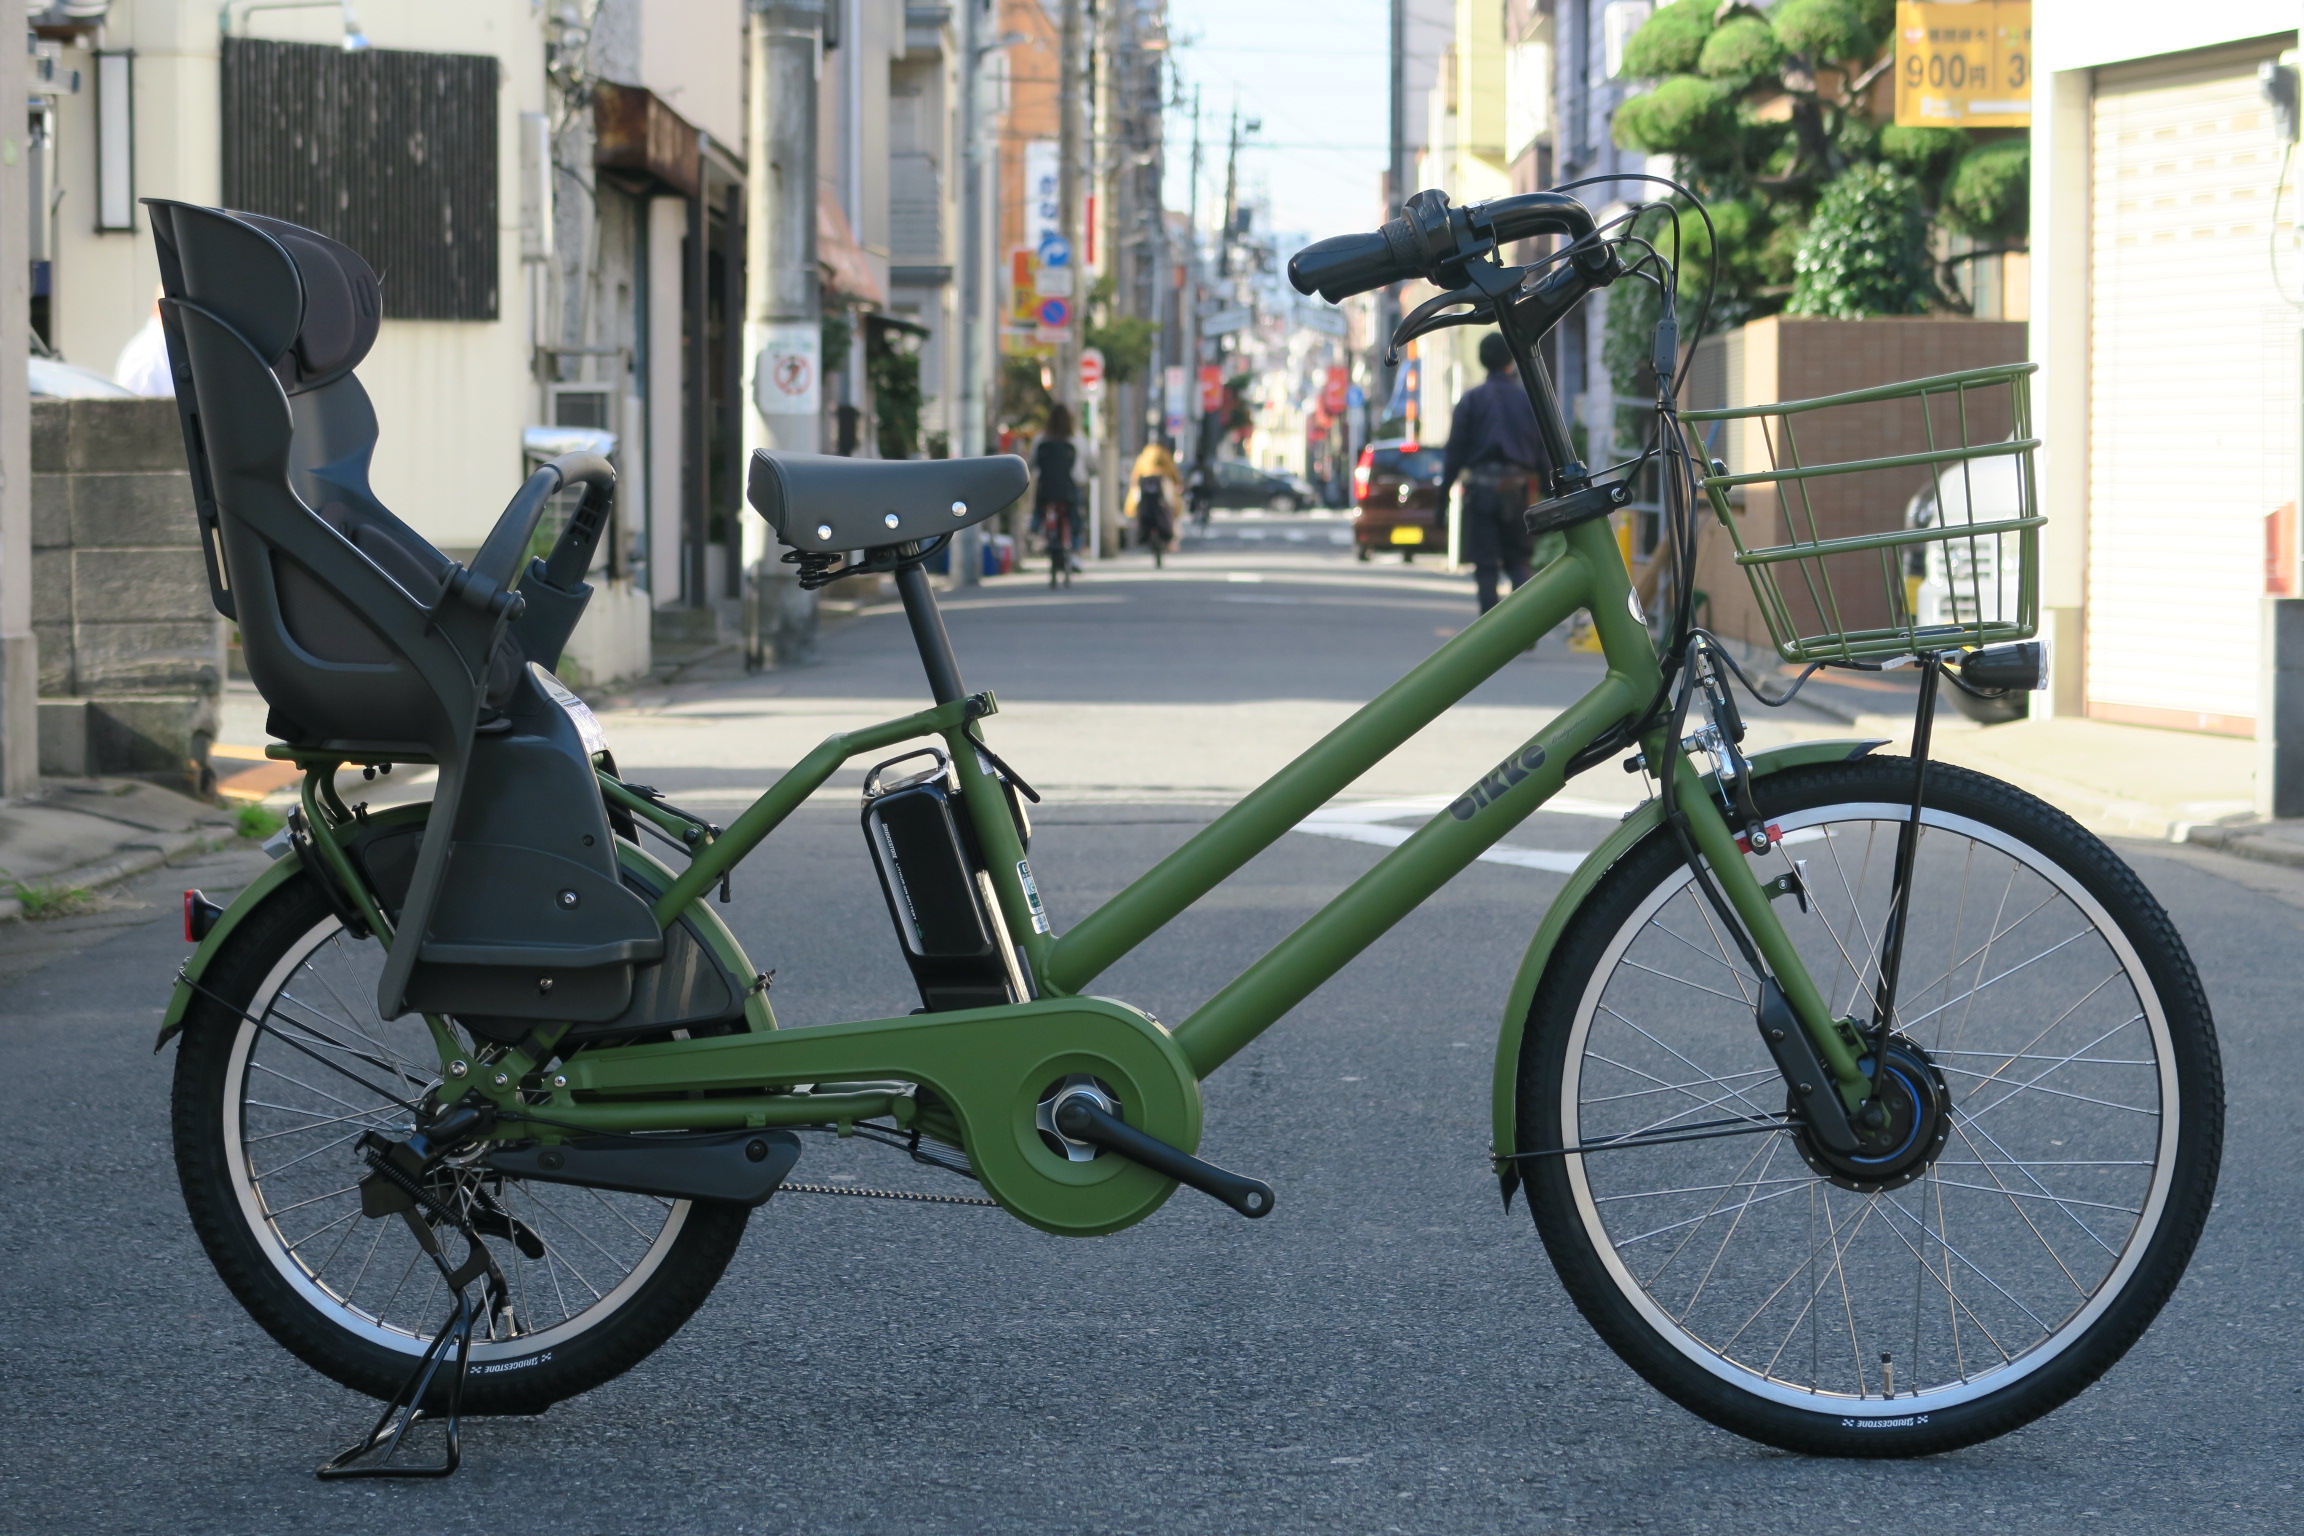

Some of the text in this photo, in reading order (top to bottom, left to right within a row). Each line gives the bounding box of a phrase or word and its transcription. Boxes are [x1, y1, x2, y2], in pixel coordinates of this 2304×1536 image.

[881, 823, 898, 859] BRIDGESTONE
[484, 1356, 539, 1373] BRIDGESTONE
[1856, 1416, 1914, 1428] BRIDGESTONE
